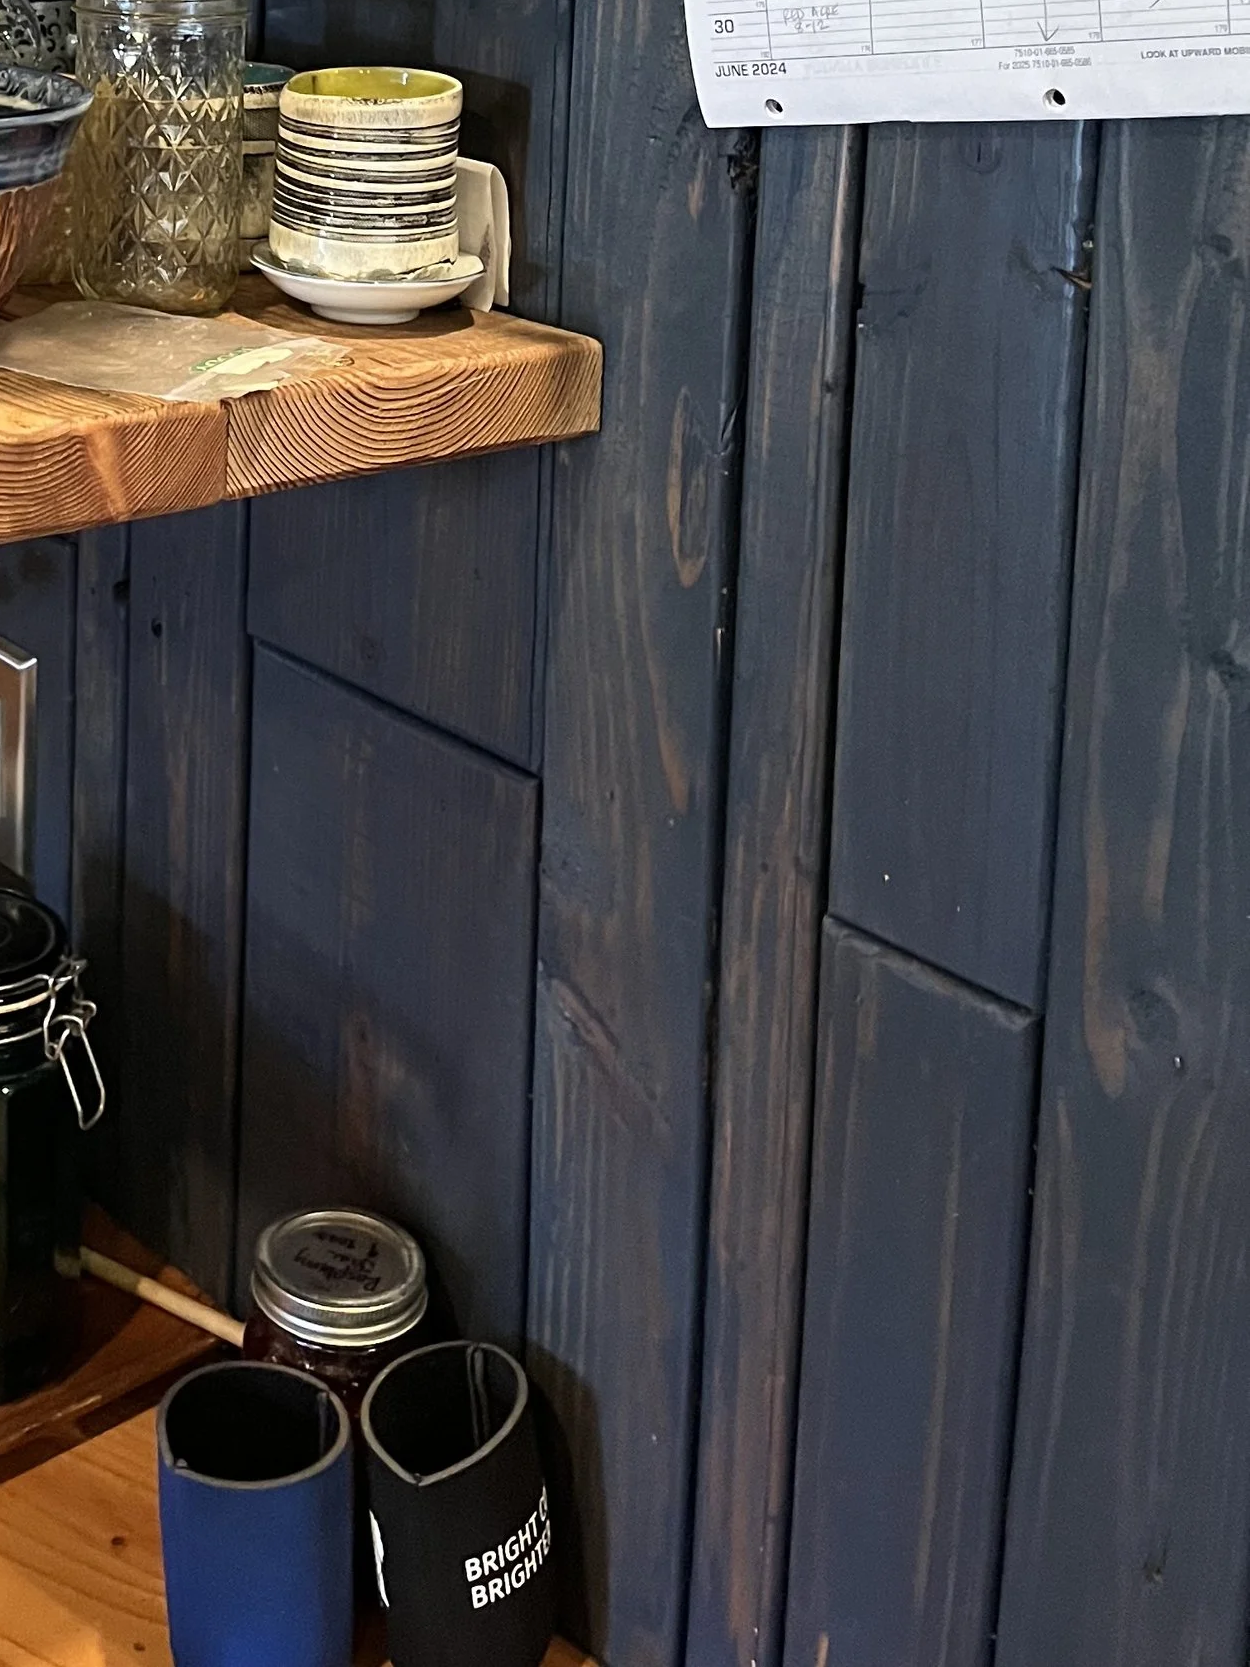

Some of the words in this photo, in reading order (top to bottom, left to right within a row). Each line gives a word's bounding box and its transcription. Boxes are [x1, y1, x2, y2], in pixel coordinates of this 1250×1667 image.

[714, 19, 735, 34] 30
[1141, 50, 1167, 60] LOOK
[1168, 49, 1179, 58] AT
[1181, 47, 1222, 57] UPWARD
[715, 62, 750, 78] JUNE
[752, 62, 787, 77] 2024
[998, 61, 1011, 71] For
[464, 1510, 538, 1583] BRIGHT
